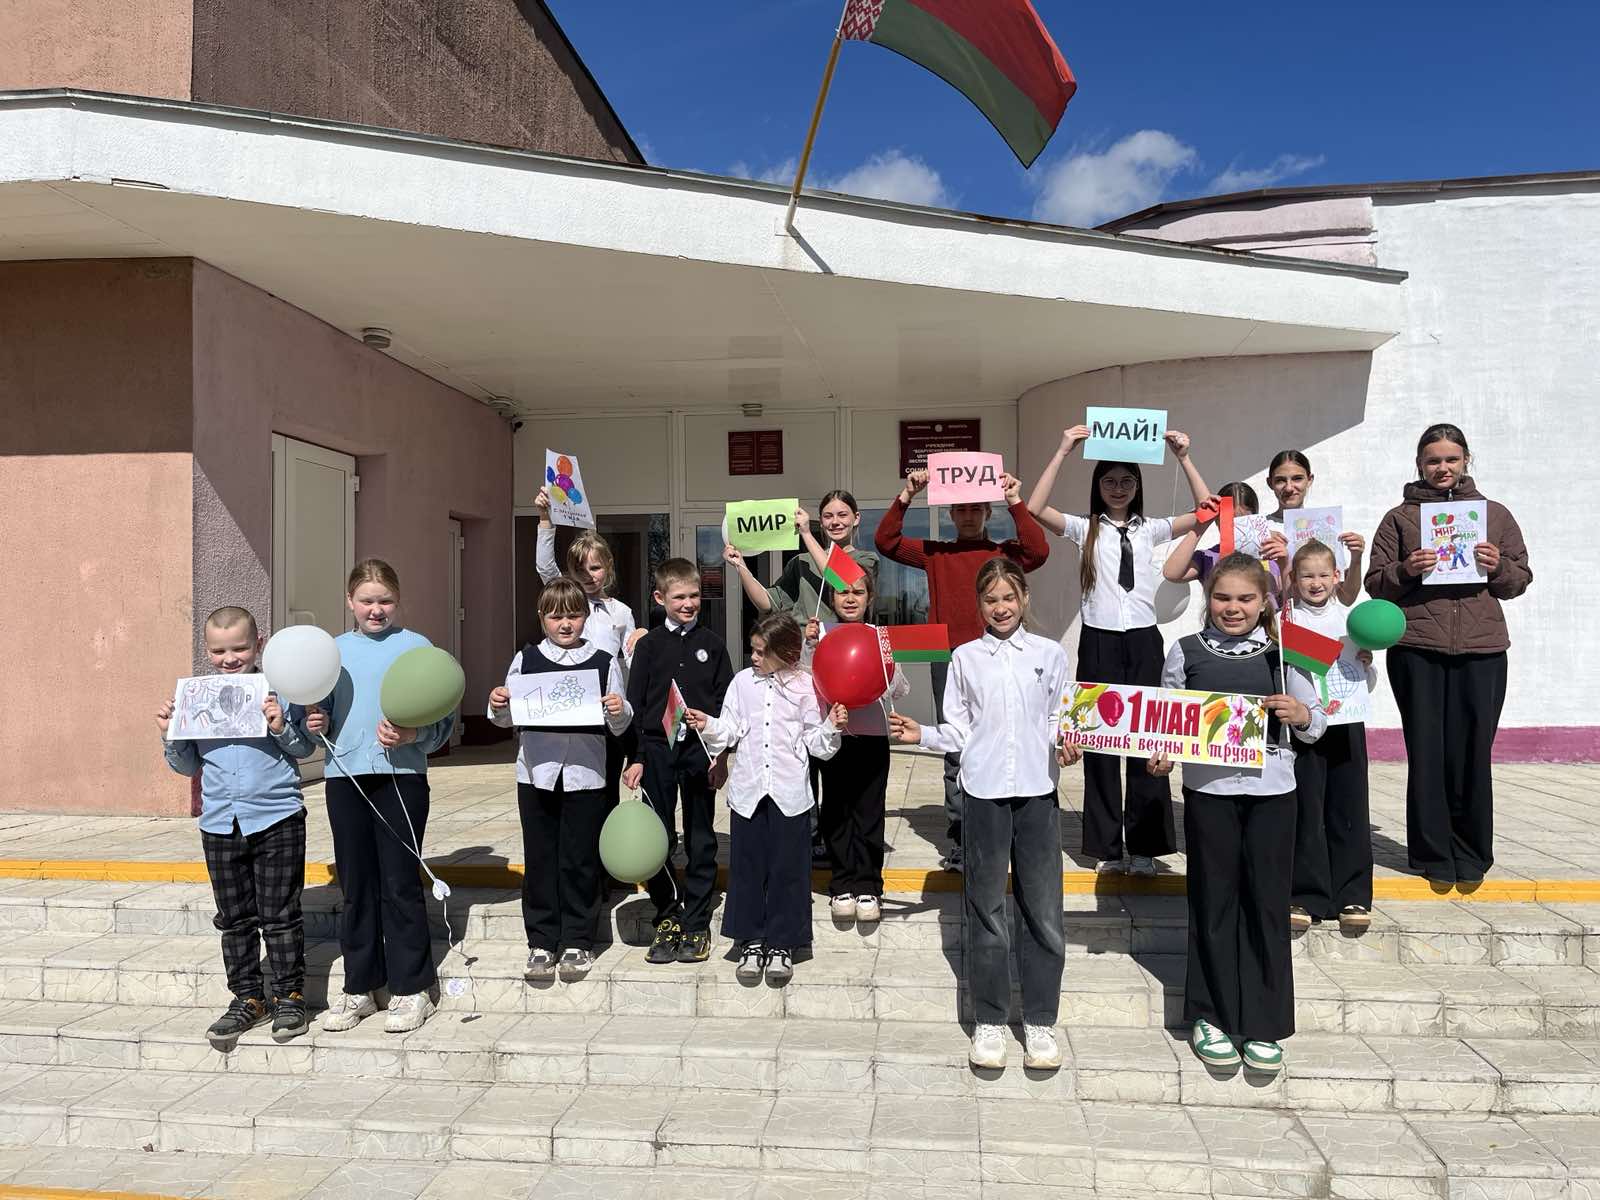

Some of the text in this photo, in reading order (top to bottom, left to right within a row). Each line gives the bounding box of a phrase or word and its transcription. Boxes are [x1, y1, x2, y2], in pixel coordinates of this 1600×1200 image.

[1092, 418, 1158, 442] МАЙ!
[936, 465, 997, 487] ТРУД
[737, 513, 787, 533] МИР
[1128, 691, 1200, 737] 1 МАЯ
[1138, 738, 1183, 755] весны
[1191, 743, 1200, 756] и
[1209, 743, 1256, 762] труда
